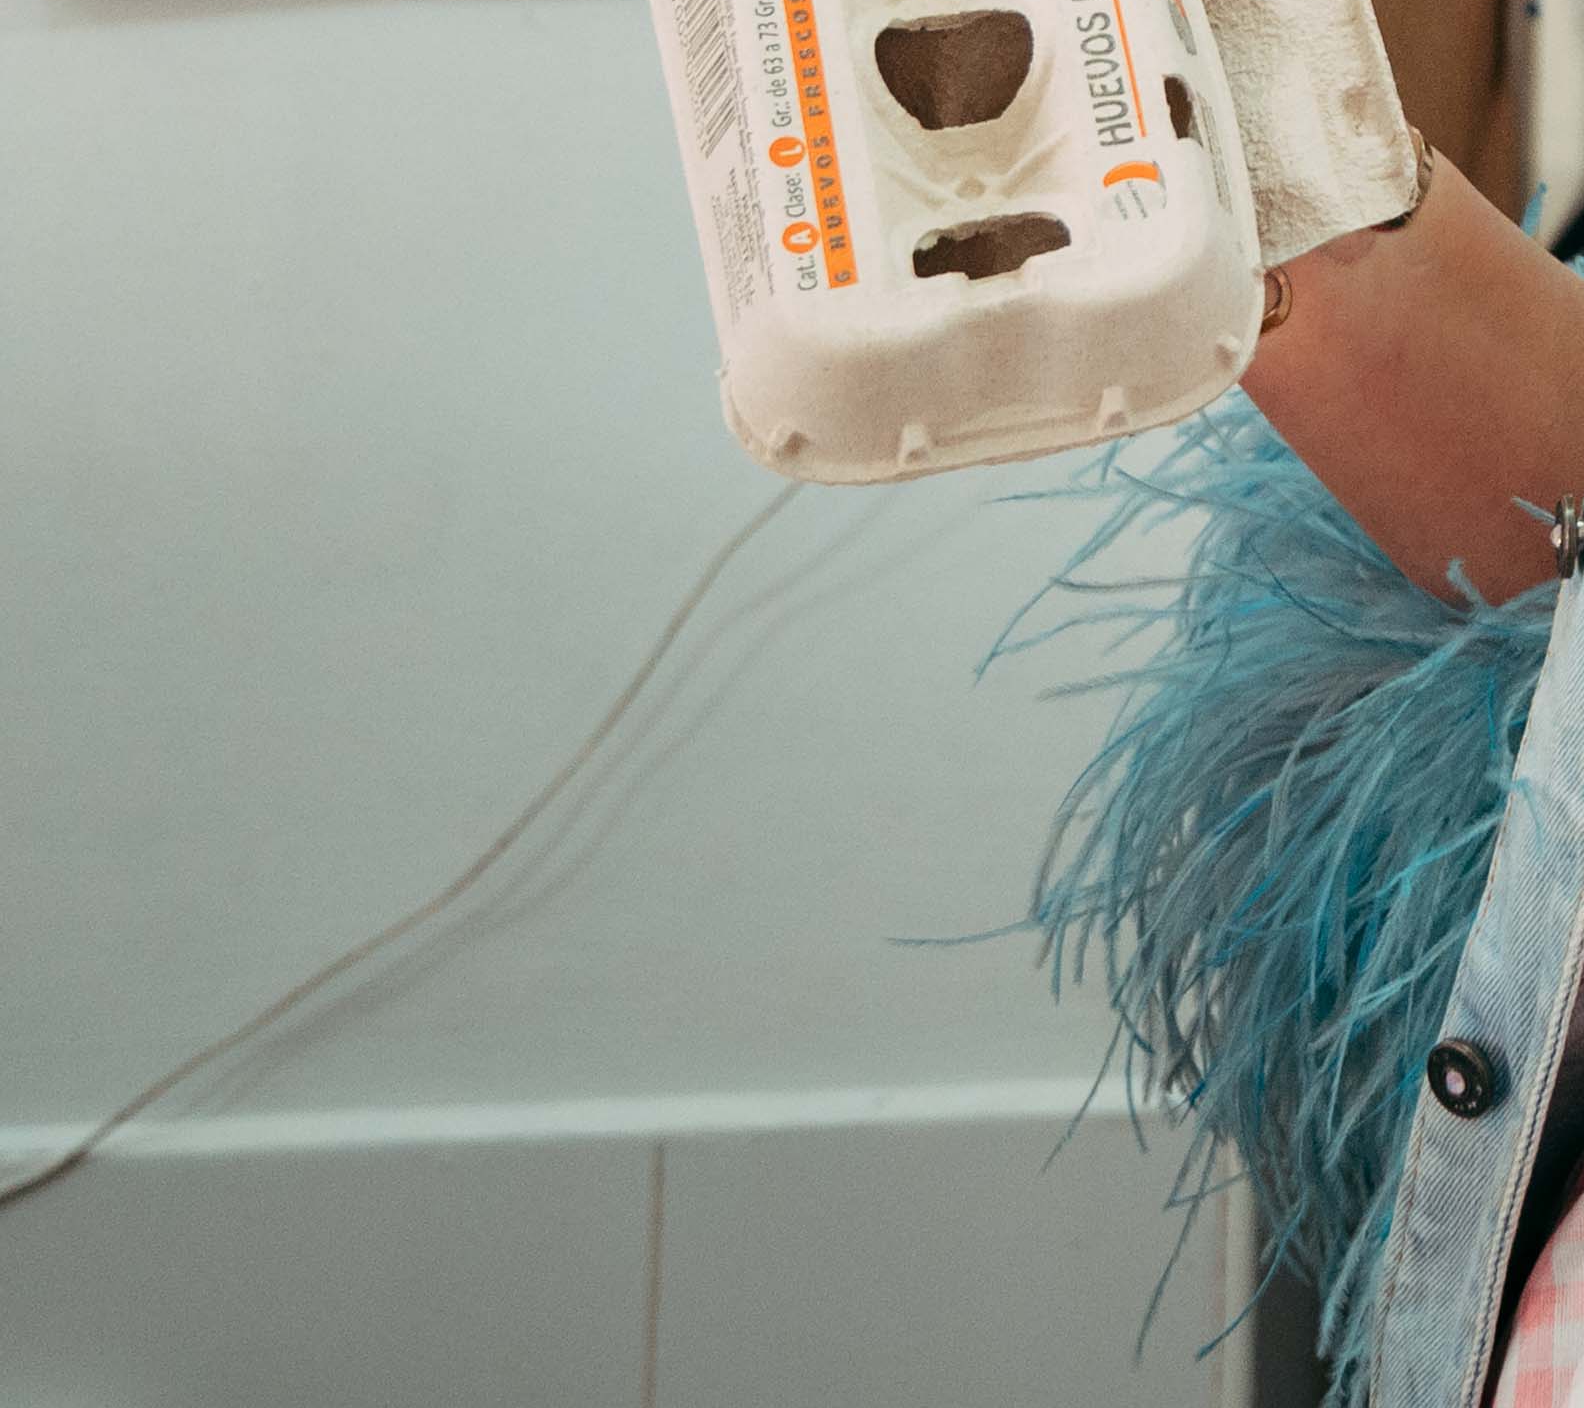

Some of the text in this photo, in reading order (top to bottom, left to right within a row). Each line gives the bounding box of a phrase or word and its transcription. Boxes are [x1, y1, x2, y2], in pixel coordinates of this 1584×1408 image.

[757, 20, 780, 41] 73
[766, 42, 782, 53] a
[762, 55, 785, 76] 63
[766, 77, 788, 98] de
[1076, 10, 1135, 149] HUEVOS
[771, 99, 793, 129] Gr.:
[779, 142, 803, 156] L
[784, 172, 807, 218] Clase:
[811, 135, 847, 251] HUEVOS
[788, 228, 813, 245] A
[797, 254, 819, 292] Cat.:
[833, 269, 852, 284] 6
